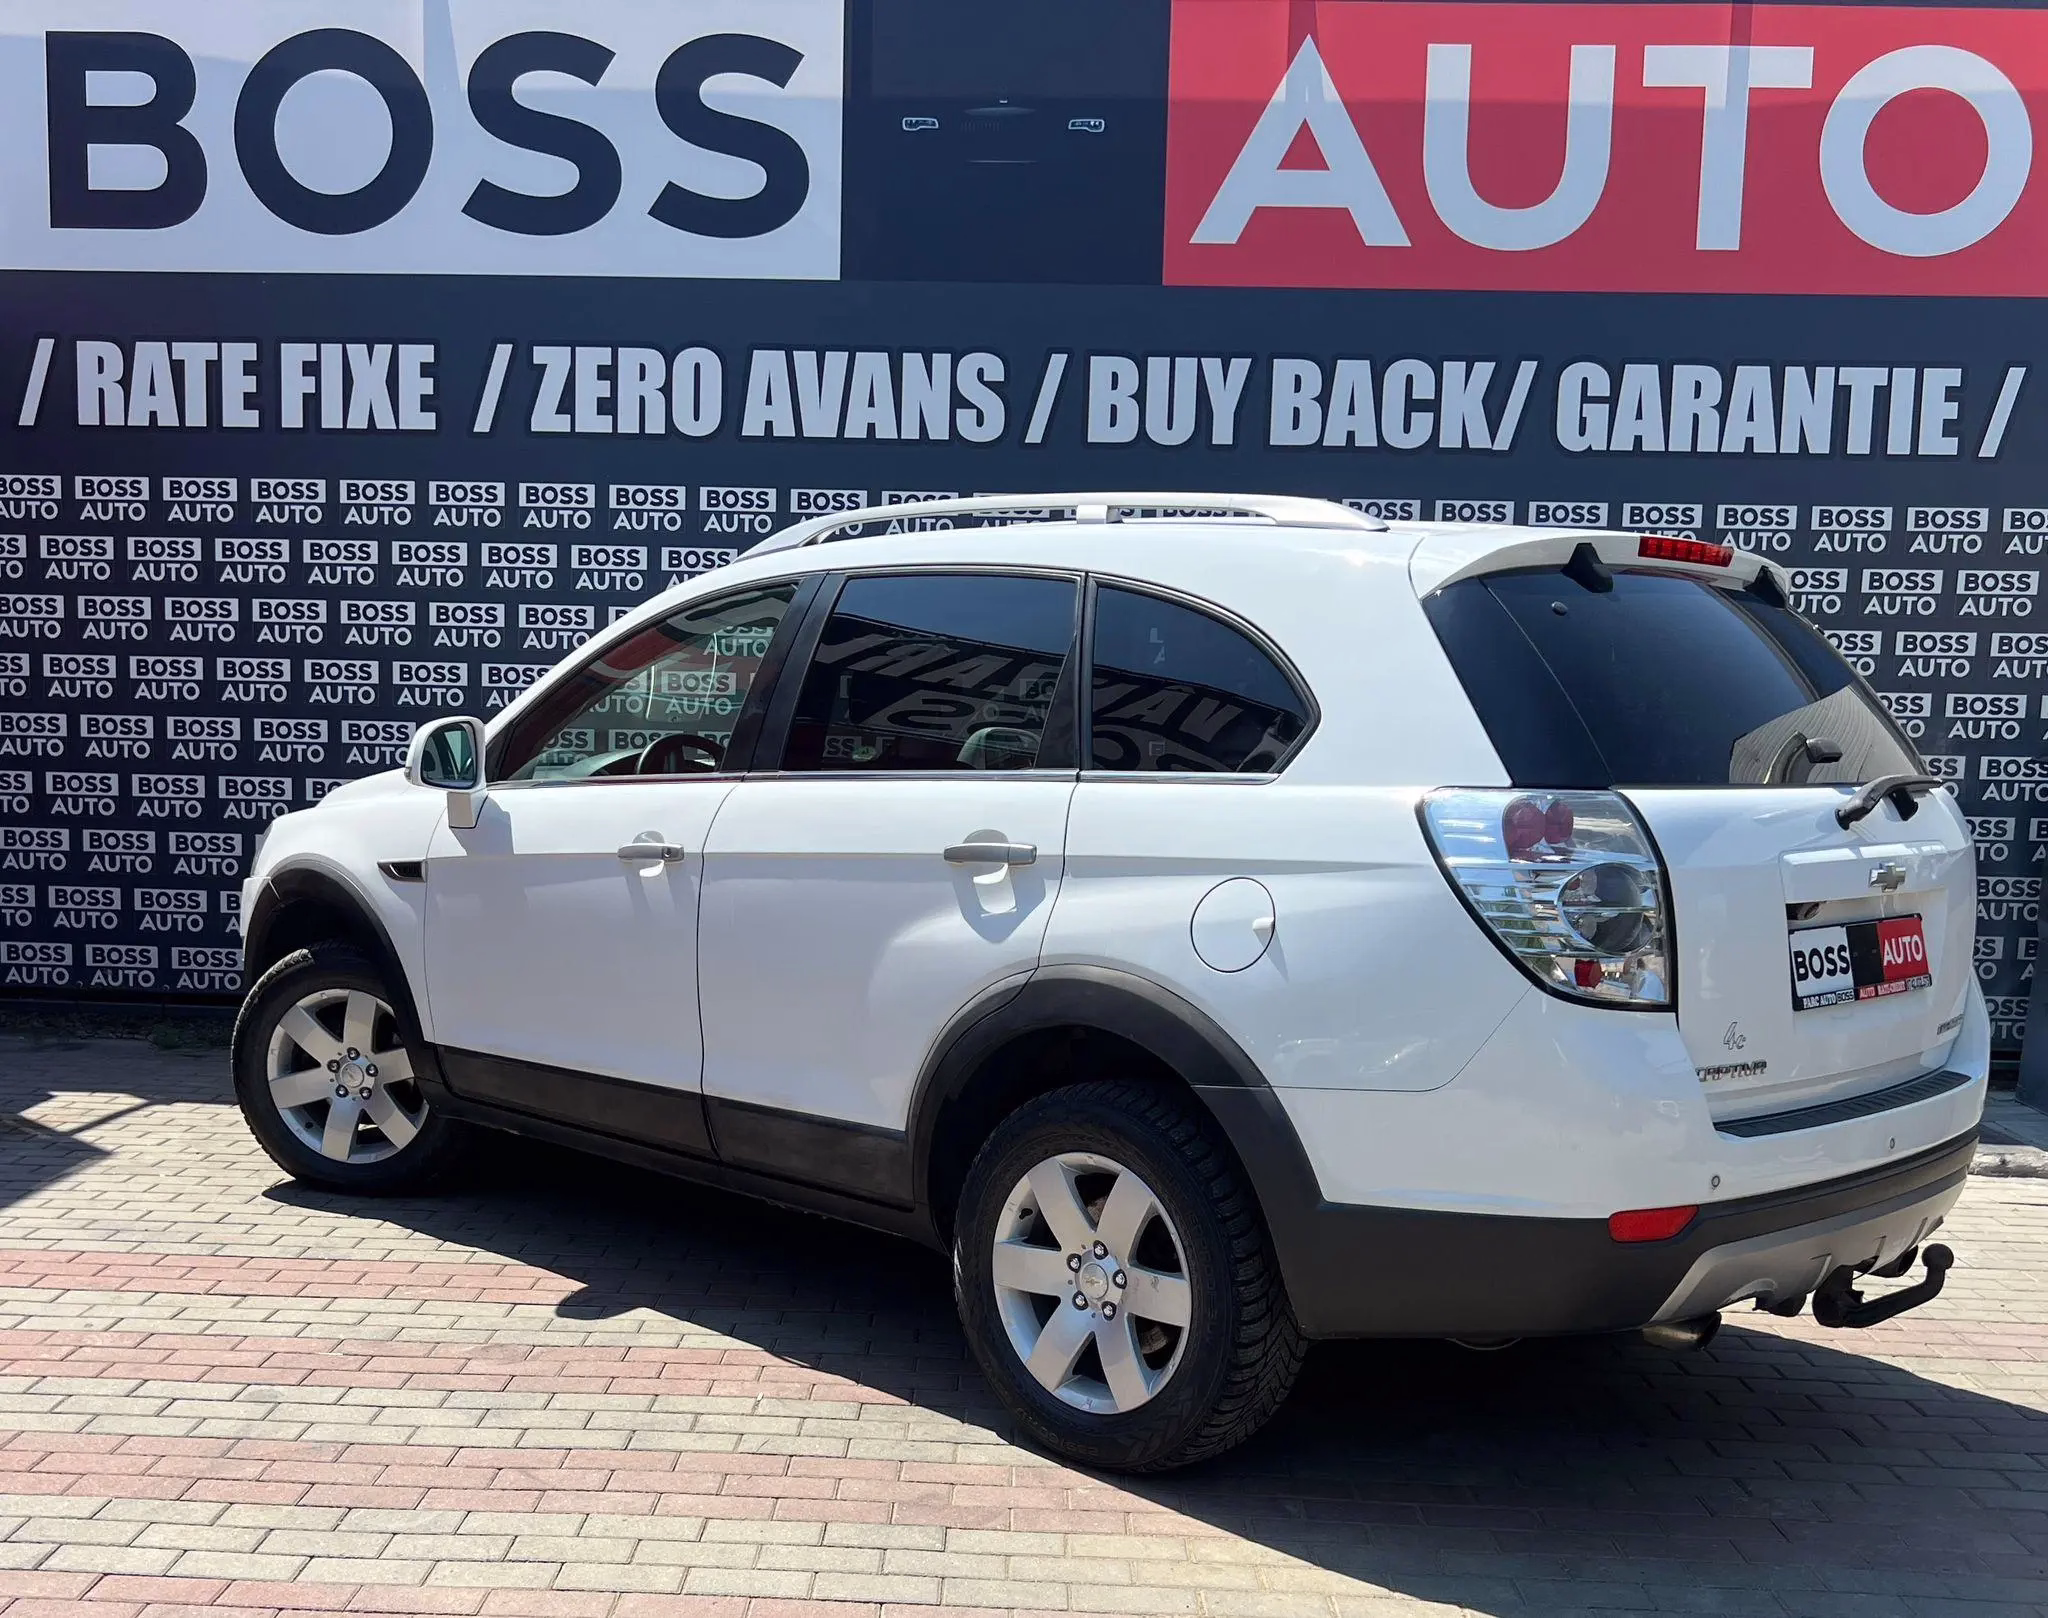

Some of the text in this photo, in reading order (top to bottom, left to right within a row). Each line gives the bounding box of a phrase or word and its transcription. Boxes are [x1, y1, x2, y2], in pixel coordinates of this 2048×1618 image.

[46, 28, 807, 238] BOSS
[1189, 34, 2032, 257] AUTO
[76, 341, 259, 428] RATE
[280, 343, 436, 431] FIXE
[531, 346, 722, 436] ZERO
[742, 350, 1004, 442] AVANS
[1087, 356, 1252, 446] BUY
[1556, 362, 1958, 455] GARANTIE
[82, 479, 142, 497] BOSS
[170, 480, 230, 498] BOSS
[258, 481, 319, 500] BOSS
[347, 483, 408, 501] BOSS
[436, 484, 498, 503] BOSS
[526, 486, 588, 505] BOSS
[616, 488, 678, 507] BOSS
[707, 490, 769, 509] BOSS
[798, 492, 860, 510] BOSS
[80, 503, 145, 521] AUTO
[168, 504, 233, 522] AUTO
[256, 505, 322, 523] AUTO
[344, 506, 411, 525] AUTO
[434, 508, 501, 527] AUTO
[523, 510, 591, 529] AUTO
[1442, 504, 1506, 522] BOSS
[1535, 504, 1600, 523] BOSS
[1630, 506, 1694, 525] BOSS
[1724, 508, 1789, 526] BOSS
[1819, 509, 1884, 528] BOSS
[1914, 510, 1980, 529] BOSS
[614, 512, 681, 531] AUTO
[704, 514, 772, 533] AUTO
[47, 538, 107, 557] BOSS
[134, 540, 194, 558] BOSS
[222, 541, 282, 559] BOSS
[1721, 532, 1791, 551] AUTO
[1814, 533, 1886, 552] AUTO
[1909, 534, 1982, 553] AUTO
[2005, 535, 2048, 554] AU
[310, 543, 371, 561] BOSS
[399, 544, 460, 563] BOSS
[488, 546, 550, 565] BOSS
[578, 548, 640, 567] BOSS
[668, 550, 730, 568] BOSS
[45, 561, 110, 580] AUTO
[133, 563, 198, 581] AUTO
[220, 565, 285, 583] AUTO
[308, 566, 374, 585] AUTO
[397, 568, 463, 586] AUTO
[486, 569, 553, 588] AUTO
[576, 571, 643, 591] AUTO
[1790, 570, 1840, 590] OSS
[1869, 572, 1935, 591] BOSS
[1964, 573, 2031, 592] BOSS
[0, 597, 57, 615] BOSS
[84, 598, 144, 617] BOSS
[171, 600, 232, 618] BOSS
[259, 602, 320, 620] BOSS
[347, 603, 408, 622] BOSS
[1790, 594, 1841, 614] UTO
[1864, 596, 1936, 615] AUTO
[1959, 597, 2032, 616] AUTO
[436, 605, 498, 624] BOSS
[526, 607, 587, 626] BOSS
[0, 620, 61, 638] AUTO
[83, 622, 147, 640] AUTO
[170, 623, 235, 641] AUTO
[257, 625, 323, 643] AUTO
[345, 627, 411, 645] AUTO
[434, 629, 501, 647] AUTO
[523, 631, 590, 650] AUTO
[1903, 634, 1969, 653] BOSS
[1998, 636, 2048, 654] BOS
[50, 657, 109, 675] BOSS
[136, 659, 196, 677] BOSS
[223, 660, 284, 679] BOSS
[311, 662, 372, 681] BOSS
[399, 664, 461, 683] BOSS
[1898, 658, 1969, 677] AUTO
[1993, 660, 2048, 678] AUT
[48, 680, 112, 698] AUTO
[135, 682, 200, 700] AUTO
[668, 673, 730, 692] BOSS
[222, 684, 287, 702] AUTO
[309, 686, 375, 704] AUTO
[398, 688, 464, 706] AUTO
[665, 697, 732, 715] AUTO
[1953, 697, 2019, 715] BOSS
[1, 715, 60, 733] BOSS
[87, 717, 147, 736] BOSS
[174, 719, 234, 737] BOSS
[261, 721, 321, 739] BOSS
[348, 724, 410, 742] BOSS
[1948, 720, 2020, 739] AUTO
[0, 738, 63, 756] AUTO
[86, 740, 150, 758] AUTO
[172, 742, 237, 760] AUTO
[259, 744, 324, 762] AUTO
[346, 746, 409, 764] AUTO
[1928, 758, 1958, 776] SS
[0, 774, 26, 790] SS
[52, 774, 112, 793] BOSS
[138, 777, 198, 795] BOSS
[225, 779, 285, 797] BOSS
[0, 796, 30, 814] TO
[51, 797, 115, 815] AUTO
[137, 800, 202, 817] AUTO
[224, 802, 289, 820] AUTO
[4, 830, 63, 848] BOSS
[89, 832, 149, 850] BOSS
[175, 834, 236, 853] BOSS
[3, 852, 66, 870] AUTO
[1976, 843, 2008, 861] TO
[88, 855, 152, 873] AUTO
[174, 857, 238, 875] AUTO
[0, 887, 29, 904] SS
[55, 888, 114, 907] BOSS
[141, 891, 201, 909] BOSS
[2, 909, 32, 926] TO
[54, 911, 117, 929] AUTO
[139, 914, 203, 931] AUTO
[7, 944, 66, 962] BOSS
[92, 947, 152, 965] BOSS
[178, 950, 238, 968] BOSS
[1883, 934, 1923, 966] AUTO
[1793, 944, 1851, 981] BOSS
[6, 967, 69, 984] AUTO
[91, 970, 154, 987] AUTO
[177, 972, 242, 990] AUTO
